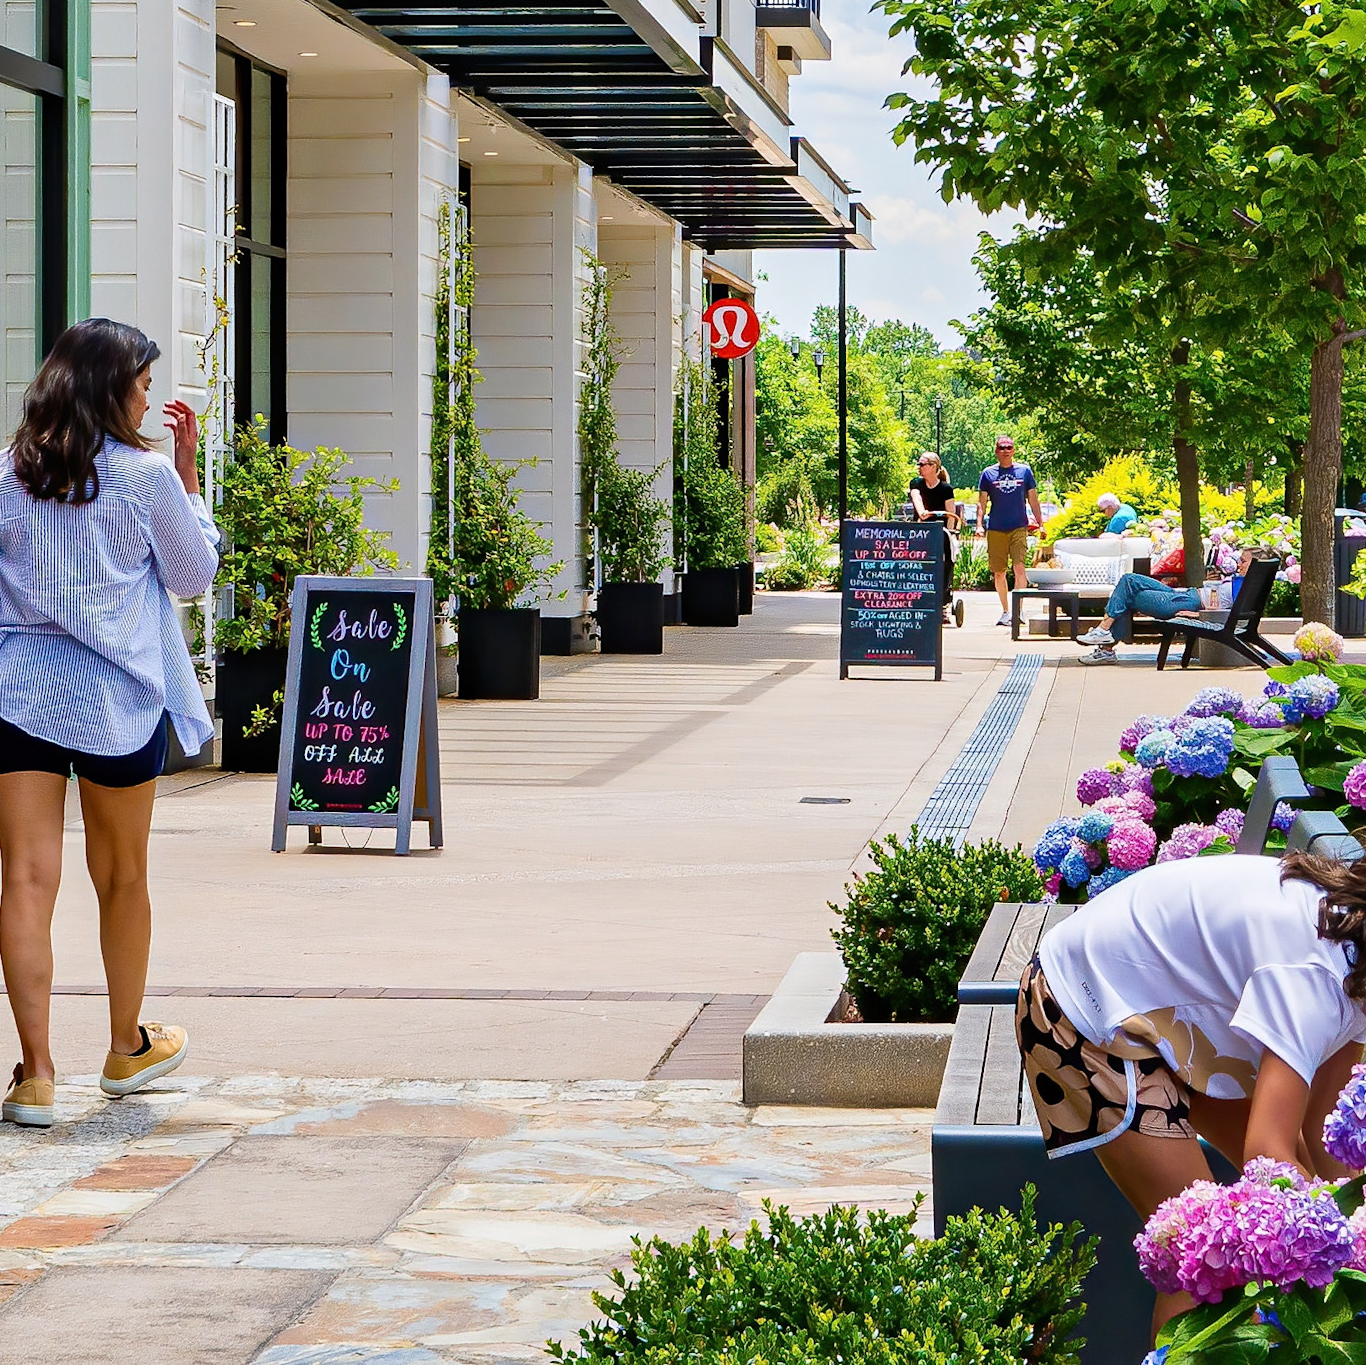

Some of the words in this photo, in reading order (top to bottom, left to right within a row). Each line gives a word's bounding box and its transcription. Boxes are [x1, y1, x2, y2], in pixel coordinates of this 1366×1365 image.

[854, 528, 906, 539] MEMORIAL
[909, 530, 930, 539] DAY
[875, 539, 910, 550] SALE!
[854, 550, 869, 559] UP
[873, 550, 886, 559] TO
[880, 561, 895, 570] OFF
[898, 562, 923, 570] SOFAS
[865, 570, 895, 580] CHAIRS
[907, 573, 934, 581] SELECT
[849, 578, 897, 589] UPHOLSTERY
[902, 582, 935, 591] LEATHER
[854, 590, 885, 600] EXTRA
[887, 592, 906, 600] 20%
[906, 592, 923, 600] OFF
[863, 600, 913, 608] CLEARANCE
[858, 610, 876, 621] 50%
[888, 611, 912, 620] AGED
[326, 608, 393, 642] Sale
[850, 620, 874, 629] STOCK
[878, 621, 914, 629] LIGHTING
[875, 628, 905, 639] RUGS
[330, 648, 371, 683] On
[309, 685, 376, 721] Sale
[305, 722, 328, 739] UP
[333, 723, 354, 742] TO
[359, 725, 390, 744] 75%
[304, 744, 338, 763] OFF
[348, 745, 385, 765] ALL
[321, 767, 367, 785] SALE
